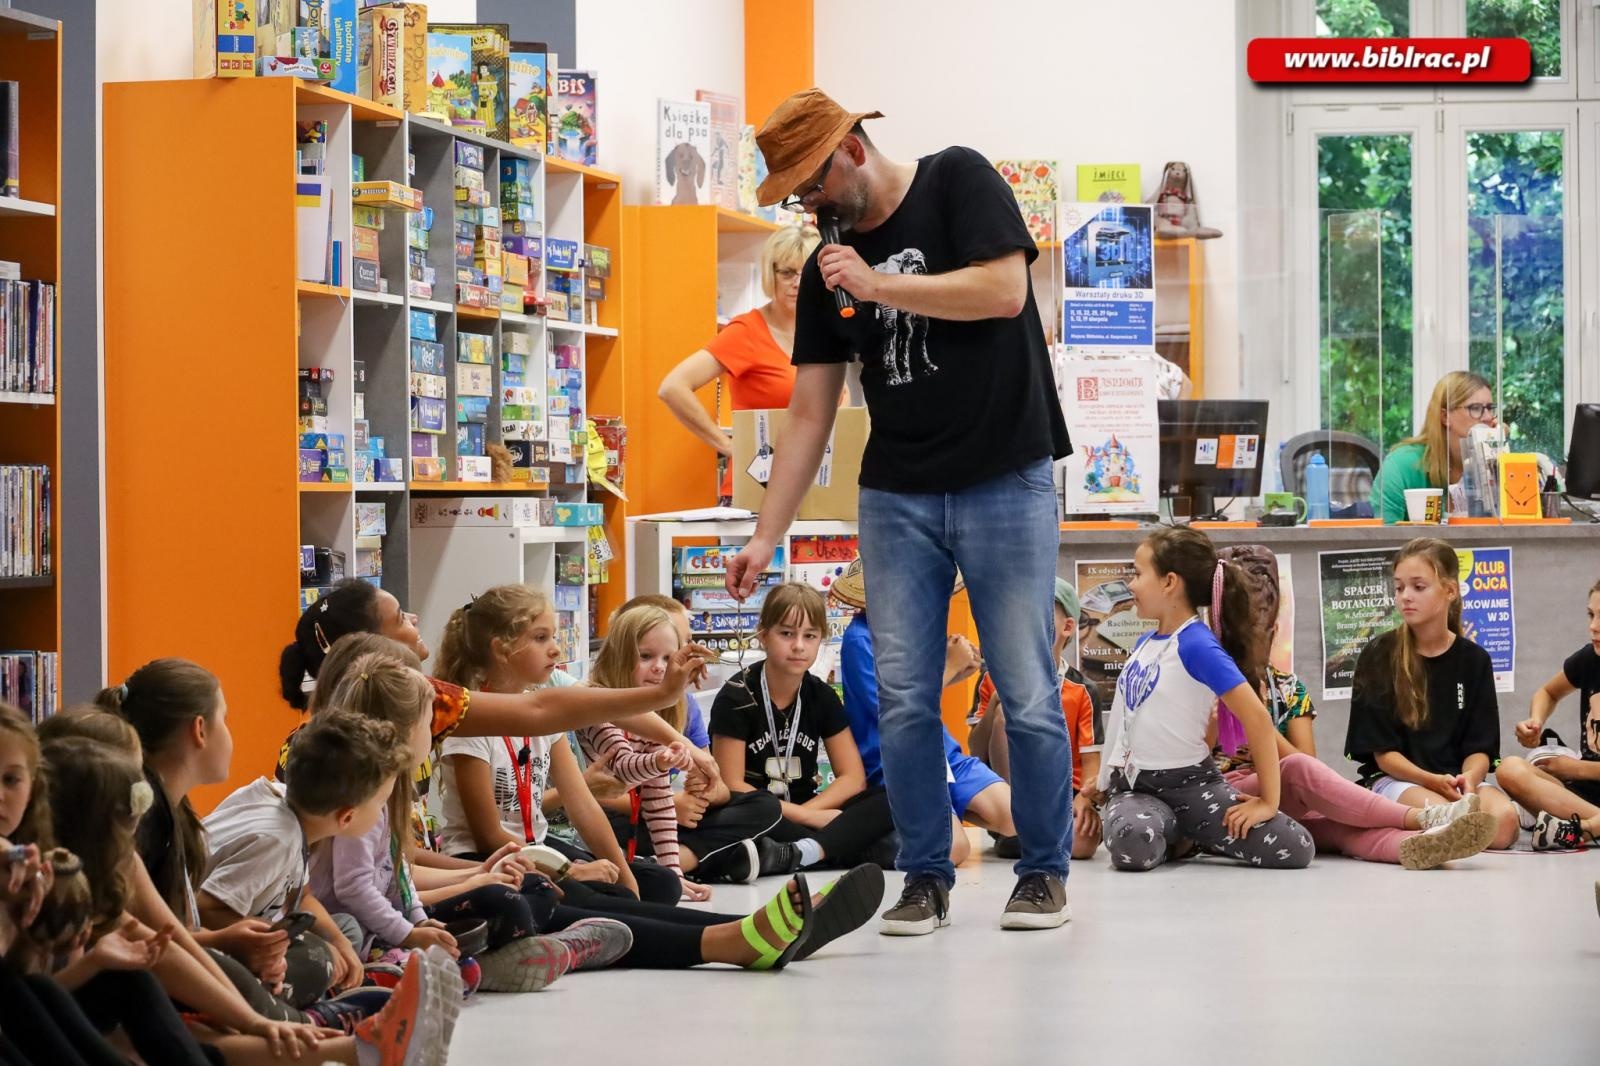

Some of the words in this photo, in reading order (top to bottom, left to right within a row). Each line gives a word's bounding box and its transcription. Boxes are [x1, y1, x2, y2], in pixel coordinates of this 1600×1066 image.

[334, 17, 344, 66] kalambury
[344, 20, 354, 64] Rodzinne
[386, 18, 400, 96] CYWILIZACJA
[664, 106, 708, 126] Książka
[665, 124, 682, 138] dla
[688, 127, 708, 142] psa
[1075, 290, 1110, 300] Warsztaty
[1112, 290, 1132, 299] druku
[1134, 291, 1144, 300] 3D
[1100, 568, 1121, 576] edycja
[1474, 560, 1505, 576] KLUB
[1344, 584, 1384, 596] SPACER
[1472, 576, 1508, 592] OJCA
[1332, 596, 1396, 610] BOTANICZNY
[1462, 598, 1509, 609] UKOWANIE
[1107, 620, 1139, 628] Racibórz
[1487, 613, 1497, 622] W
[1499, 612, 1510, 621] 3D
[1336, 622, 1357, 630] Bramy
[1082, 643, 1111, 656] Świat
[1126, 646, 1135, 658] je
[1104, 661, 1125, 670] mie
[1338, 670, 1355, 678] sierp
[778, 728, 816, 752] LEGUE
